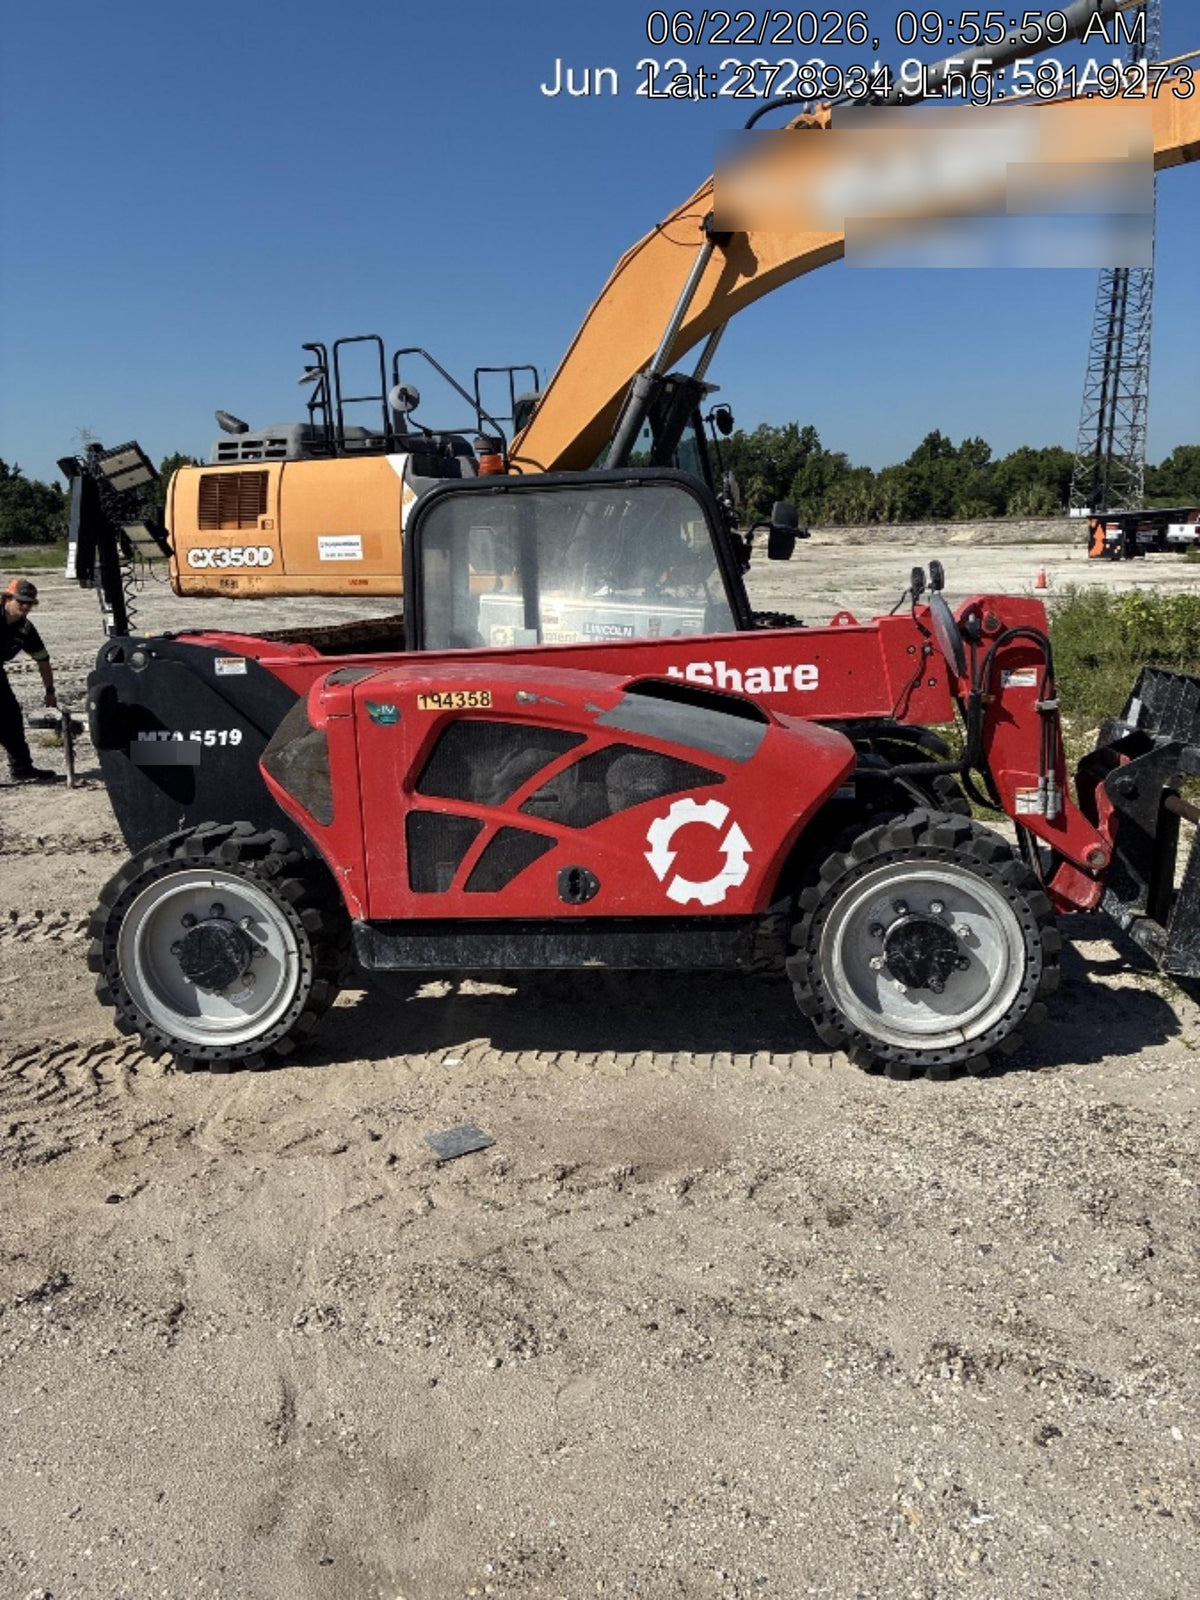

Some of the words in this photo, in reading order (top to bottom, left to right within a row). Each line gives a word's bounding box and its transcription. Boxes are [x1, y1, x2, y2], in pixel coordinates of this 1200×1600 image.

[187, 547, 274, 568] CX350D
[585, 623, 633, 637] LINCOLN
[419, 691, 490, 708] 194358
